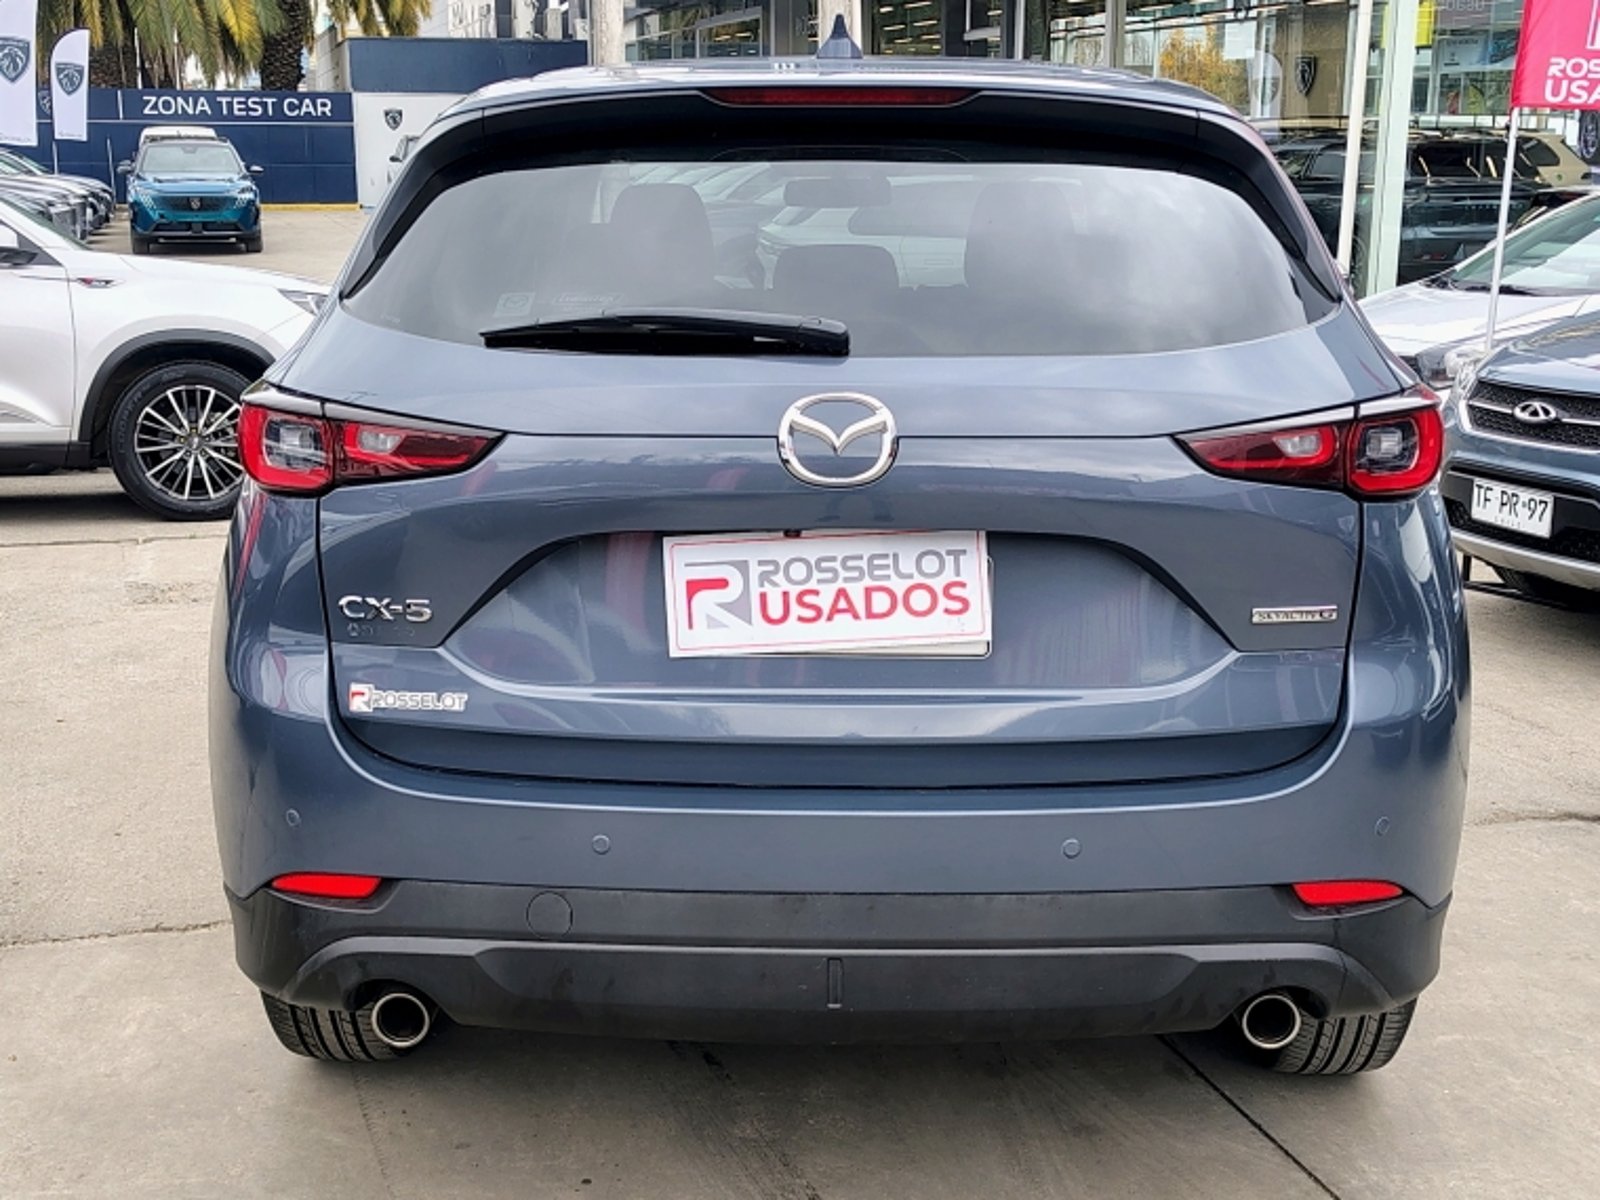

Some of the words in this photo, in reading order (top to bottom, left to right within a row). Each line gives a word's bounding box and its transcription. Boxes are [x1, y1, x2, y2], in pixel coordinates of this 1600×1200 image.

[142, 96, 211, 115] ZONA
[216, 97, 277, 116] TEST
[283, 98, 332, 117] CAR
[1475, 483, 1494, 509] TF
[757, 549, 968, 588] ROSSELOT
[338, 595, 432, 622] CX-5
[759, 581, 971, 625] USADOS
